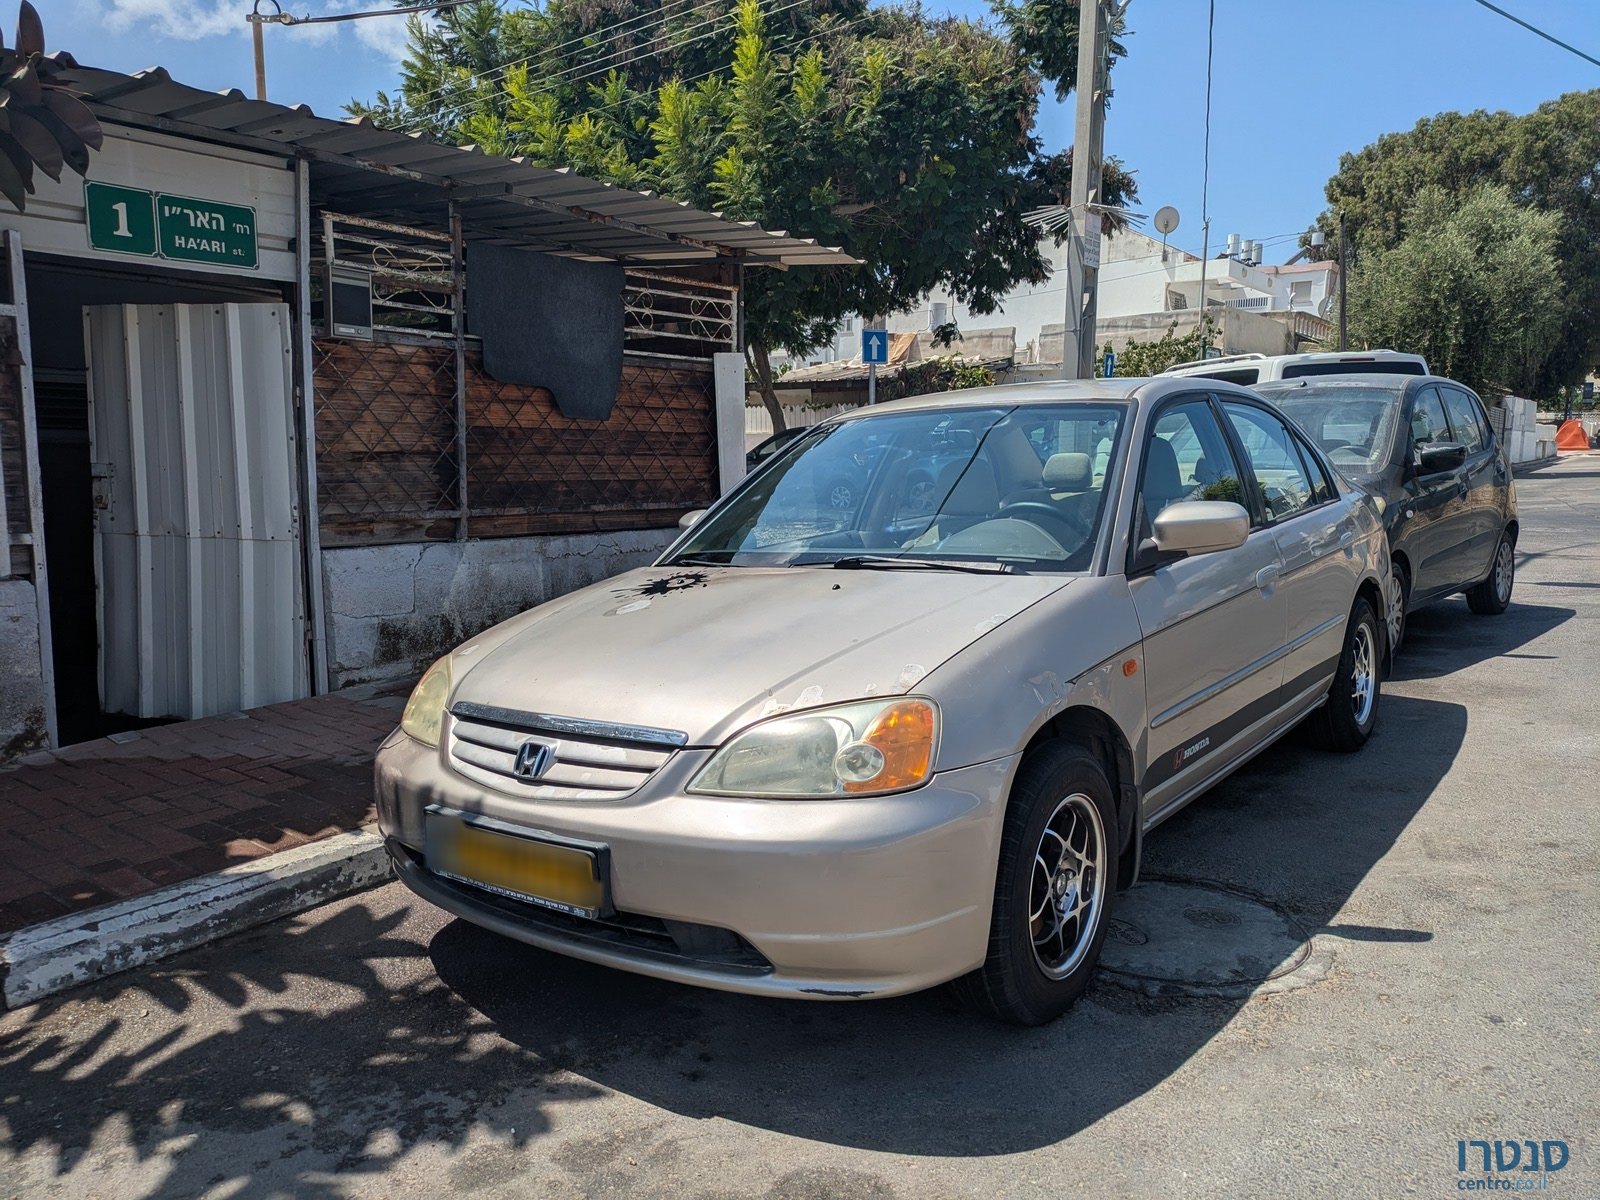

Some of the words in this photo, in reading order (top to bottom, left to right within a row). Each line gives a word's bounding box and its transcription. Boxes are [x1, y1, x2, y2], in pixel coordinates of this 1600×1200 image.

[112, 202, 133, 238] 1
[163, 205, 226, 232] האר"י
[232, 222, 250, 235] רח'
[174, 235, 226, 254] HA'ARI
[1183, 737, 1210, 760] HONDA
